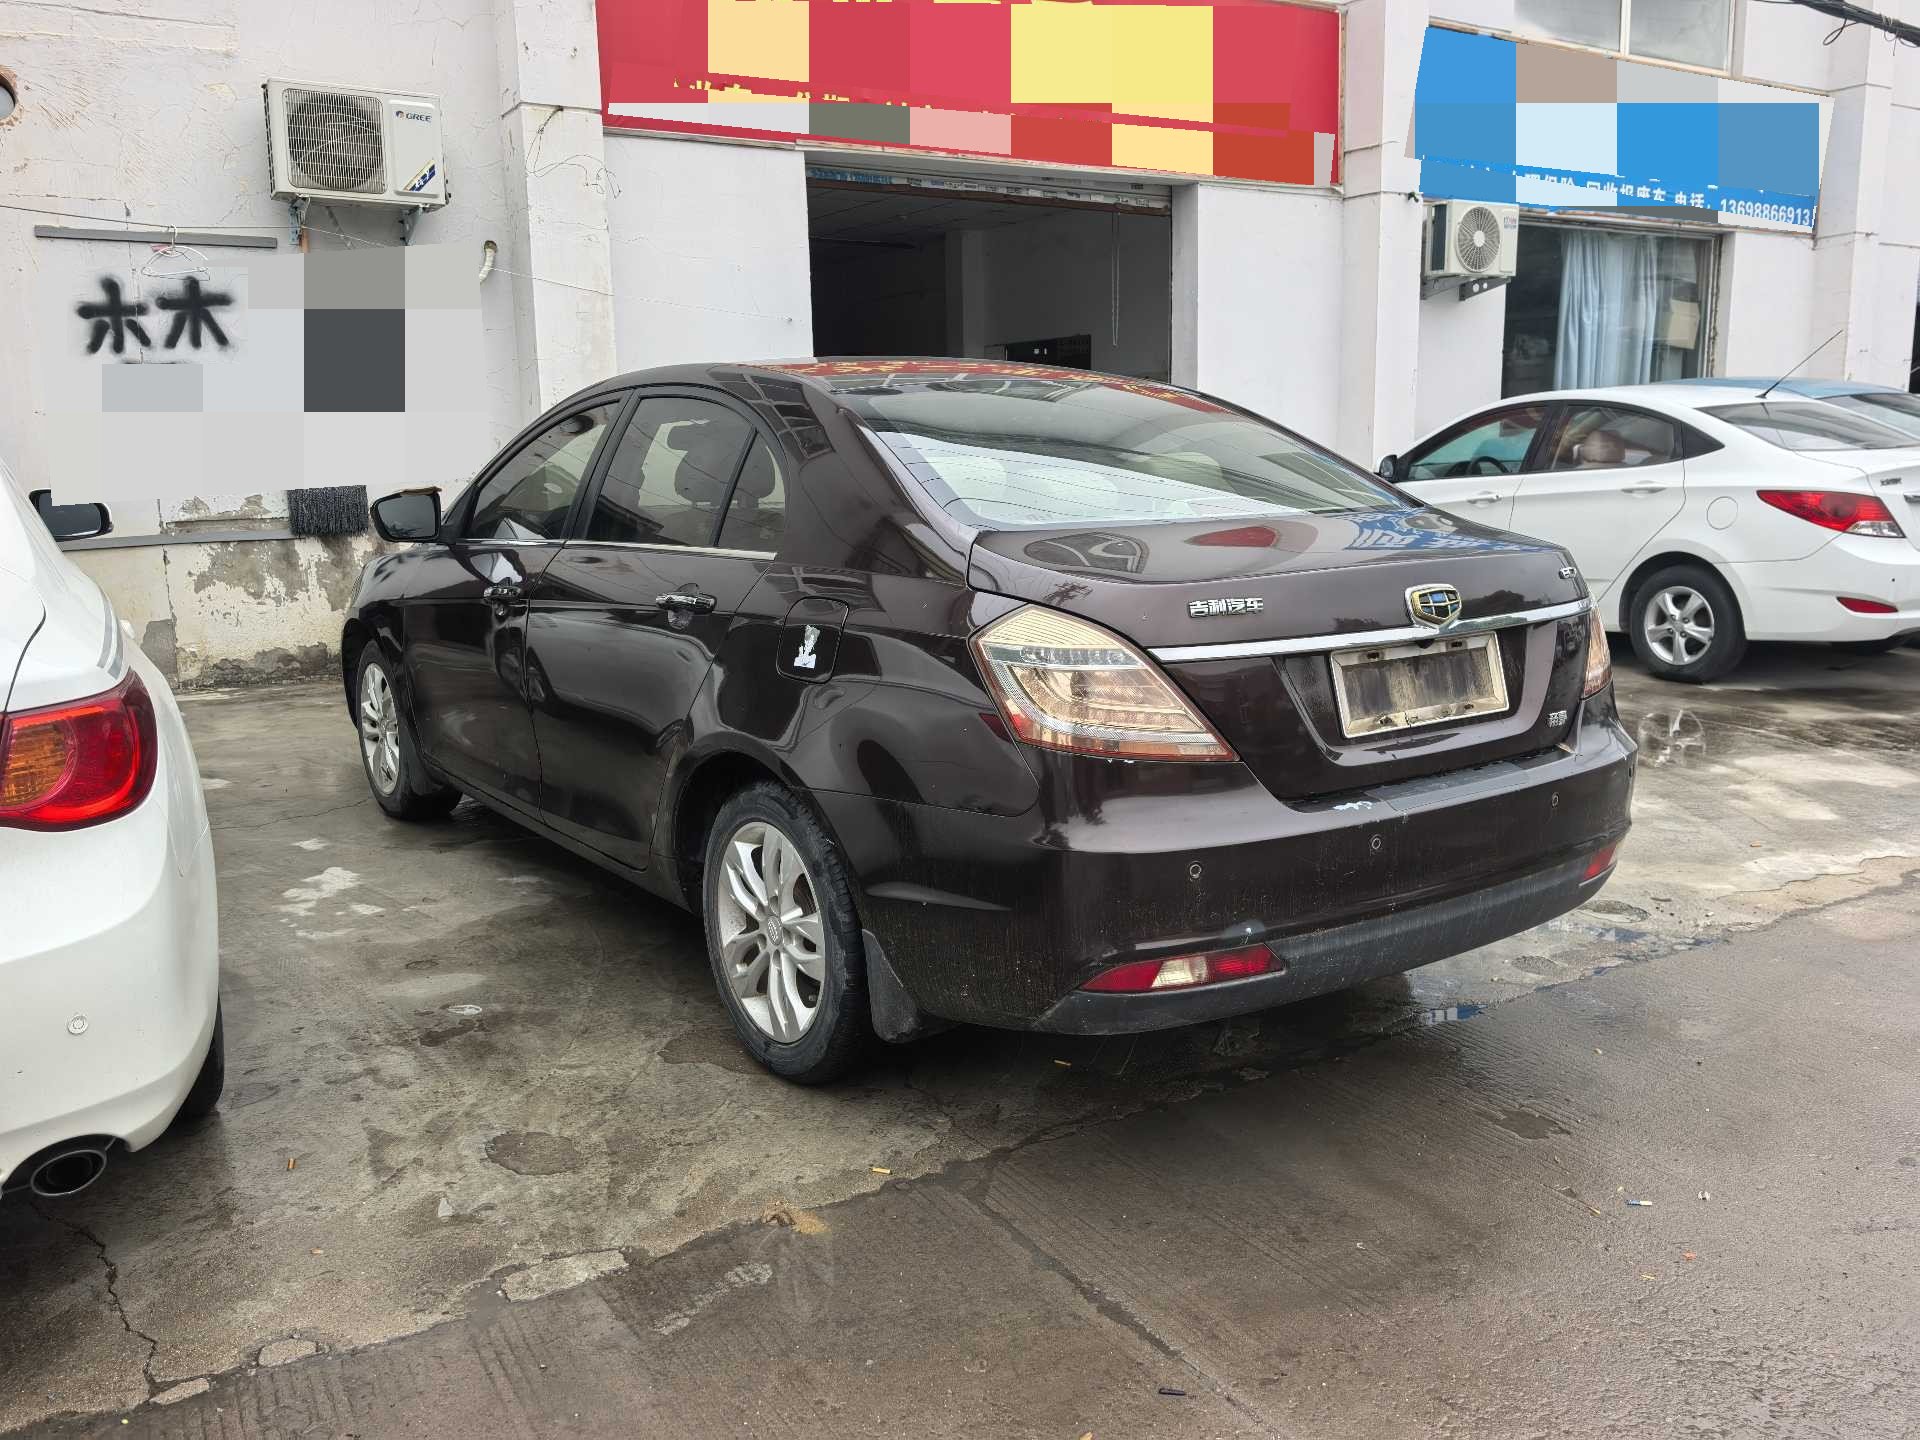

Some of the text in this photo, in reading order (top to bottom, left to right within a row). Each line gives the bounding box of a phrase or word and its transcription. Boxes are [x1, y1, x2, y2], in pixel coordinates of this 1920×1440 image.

[405, 112, 432, 122] GREE
[1188, 597, 1264, 618] 吉利汽车
